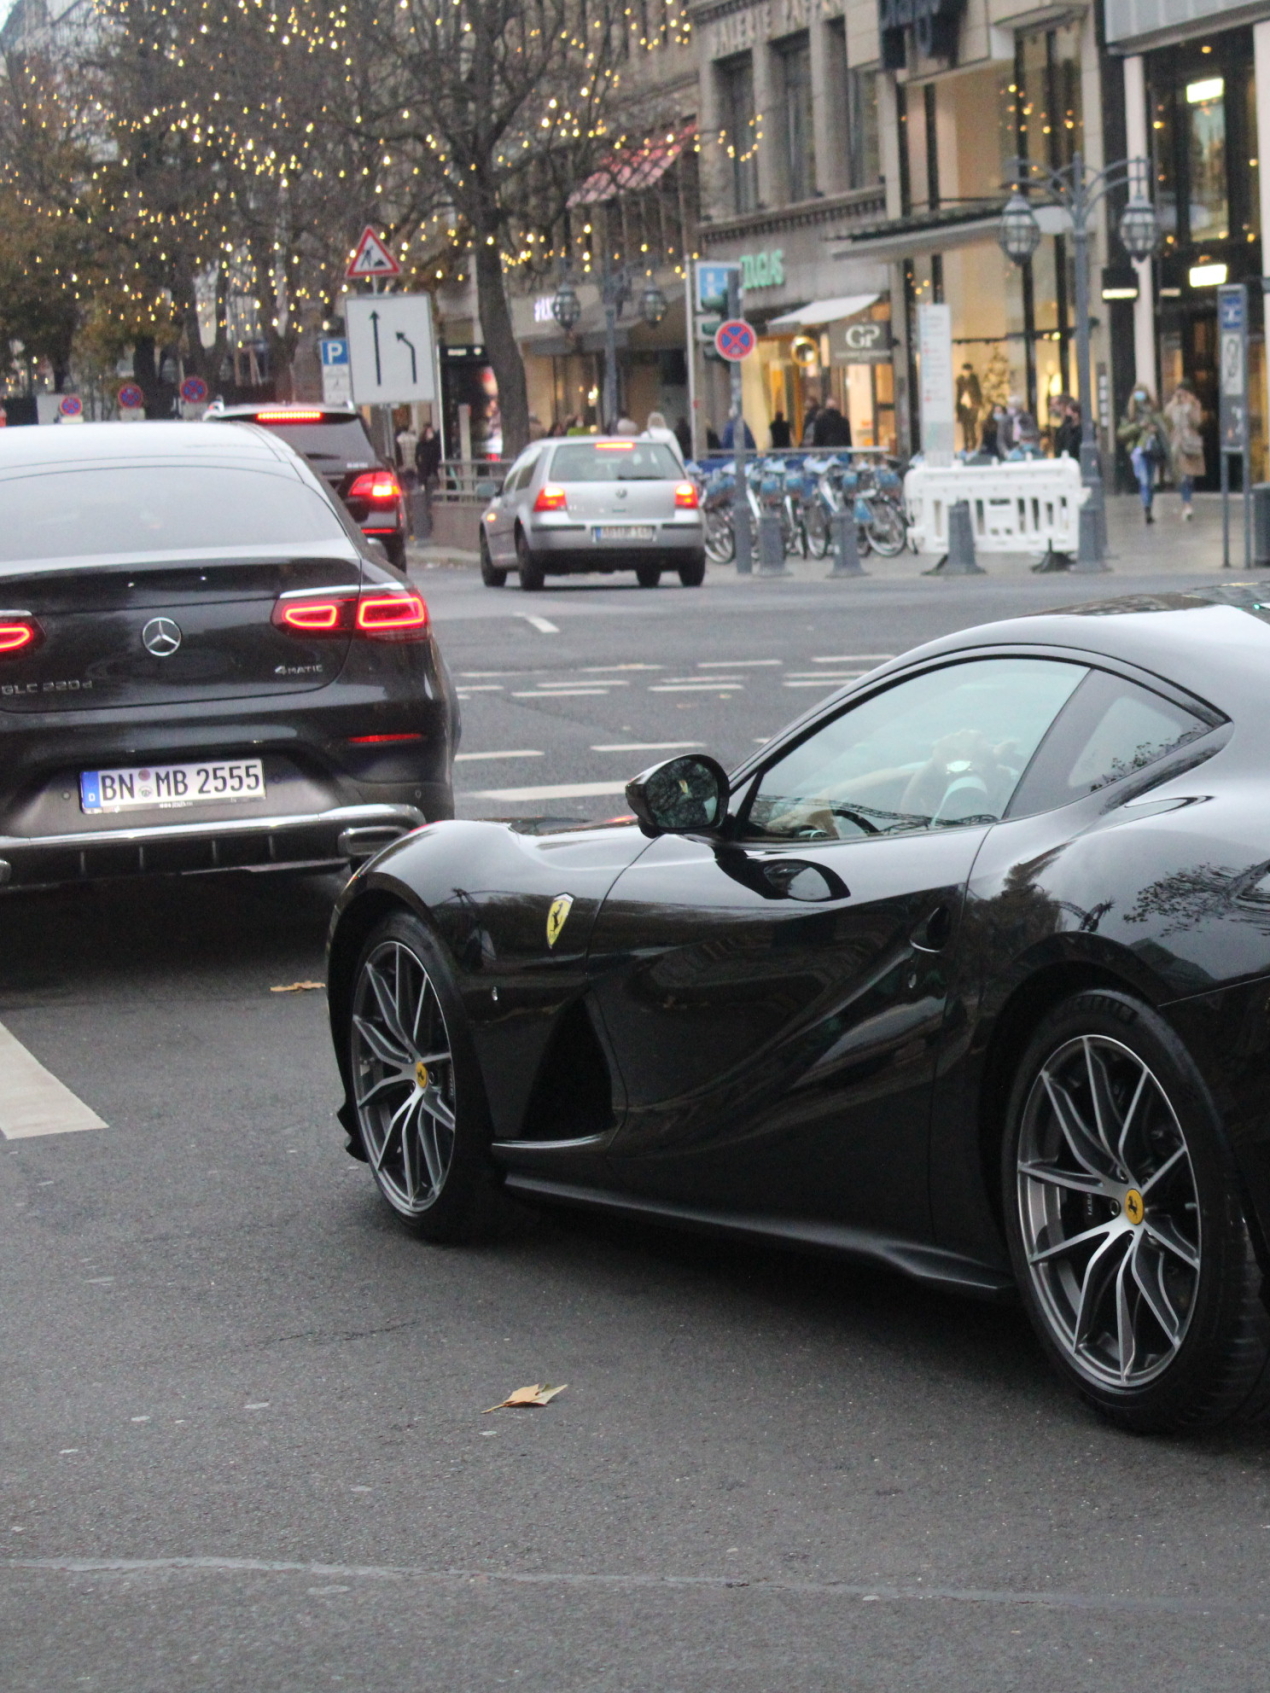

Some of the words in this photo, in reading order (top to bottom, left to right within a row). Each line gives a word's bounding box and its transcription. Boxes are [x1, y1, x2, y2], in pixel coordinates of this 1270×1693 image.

[326, 342, 343, 364] P
[274, 664, 323, 675] 4MATIC
[1, 683, 38, 695] GLC
[88, 793, 96, 802] D
[101, 773, 135, 801] BN
[155, 770, 188, 798] MB
[196, 765, 260, 794] 2555
